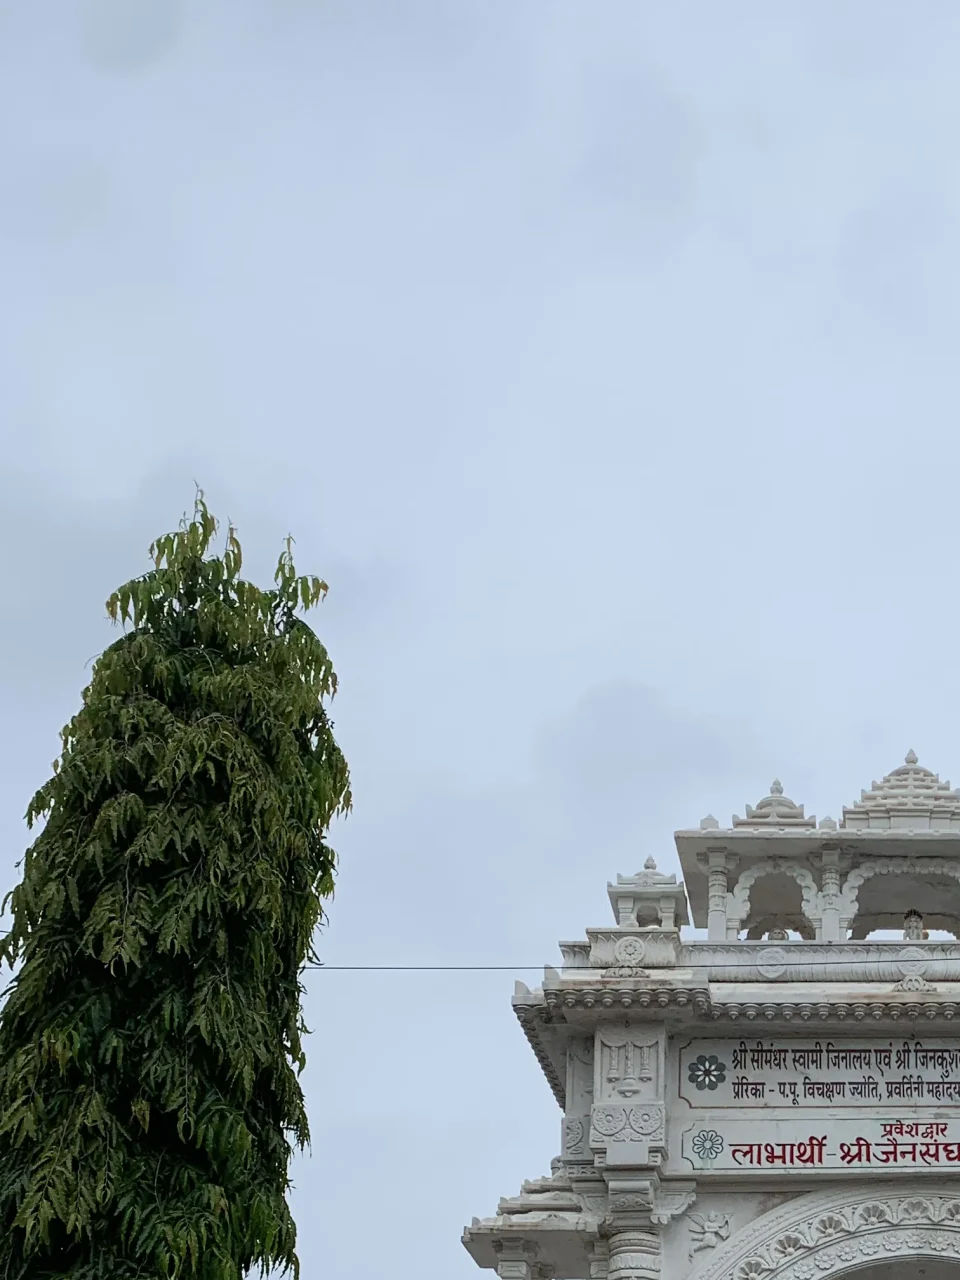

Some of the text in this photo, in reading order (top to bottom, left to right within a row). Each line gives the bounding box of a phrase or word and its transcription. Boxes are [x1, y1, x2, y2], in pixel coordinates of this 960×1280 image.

[732, 1041, 748, 1070] श्री
[750, 1041, 789, 1070] सीमंधर
[791, 1042, 823, 1070] स्वामी
[826, 1042, 872, 1070] जिनालय
[874, 1042, 892, 1077] एवं
[895, 1041, 911, 1070] श्री
[732, 1076, 765, 1099] प्रेरिका
[778, 1082, 799, 1105] प.पू.
[803, 1076, 846, 1102] विचक्षण
[848, 1075, 882, 1101] ज्योति,
[885, 1075, 924, 1099] प्रवर्तिनी
[840, 1137, 872, 1165] श्री
[873, 1138, 918, 1163] जैन
